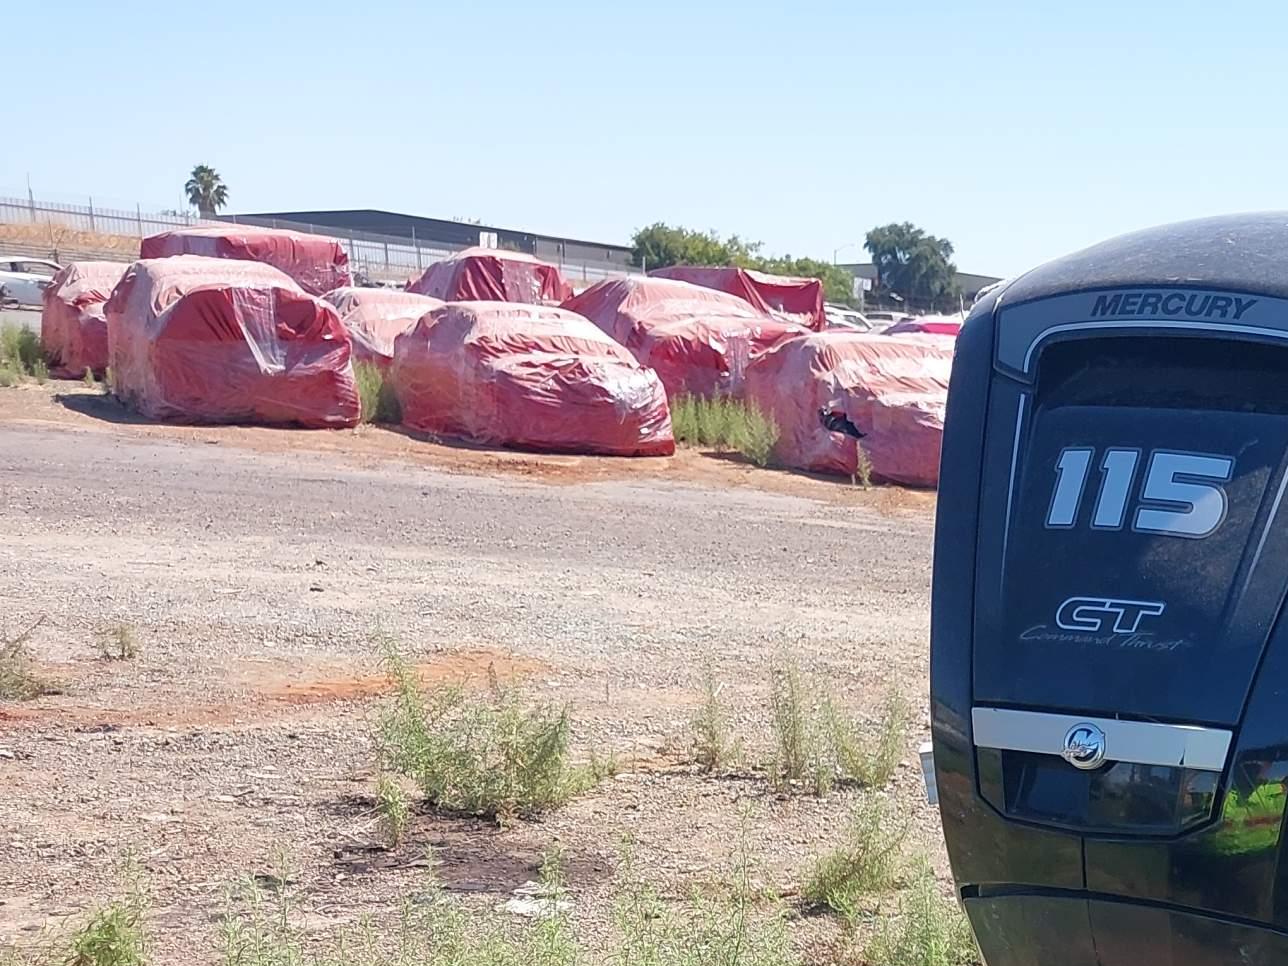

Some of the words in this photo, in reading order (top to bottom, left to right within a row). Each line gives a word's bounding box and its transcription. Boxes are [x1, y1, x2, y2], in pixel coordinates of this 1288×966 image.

[1090, 292, 1257, 320] MERCURY
[1045, 447, 1236, 539] 115
[1056, 597, 1165, 633] GT
[1019, 625, 1114, 646] Command
[1117, 631, 1183, 650] Thrust
